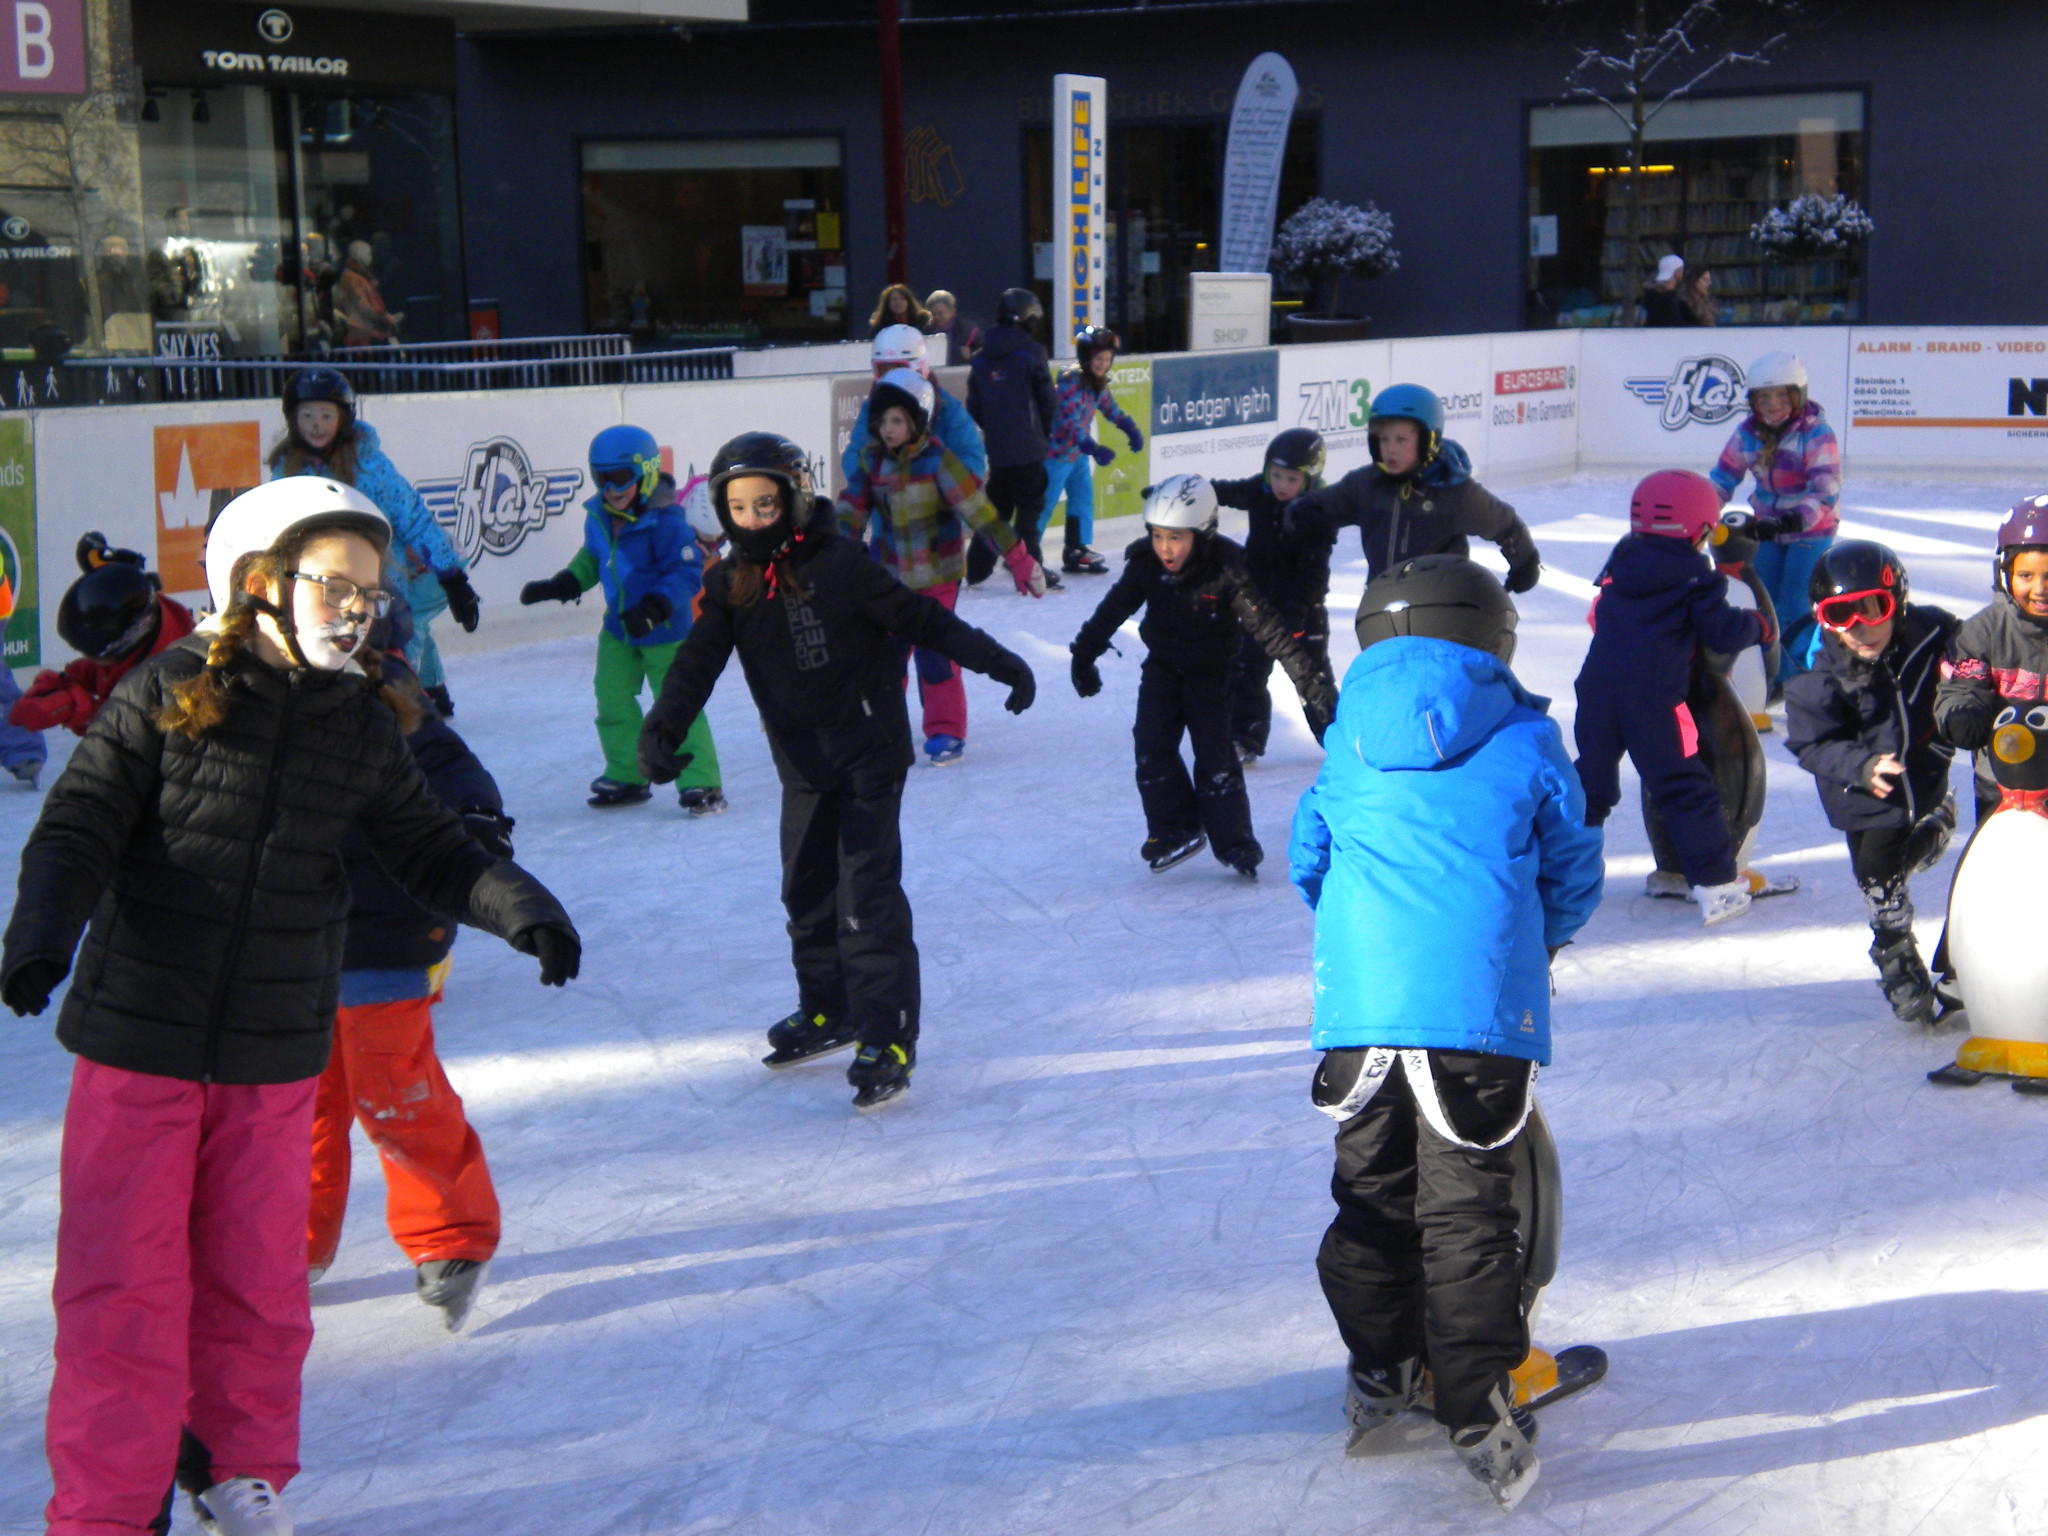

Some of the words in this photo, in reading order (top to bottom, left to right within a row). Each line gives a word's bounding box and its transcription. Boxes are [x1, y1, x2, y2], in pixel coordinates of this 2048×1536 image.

[16, 1, 54, 79] B
[203, 51, 265, 71] TOM
[267, 54, 349, 77] TAILOR
[1857, 341, 1912, 354] ALARM
[1926, 341, 1982, 354] BRAND
[1996, 341, 2047, 354] VIDEO
[1503, 370, 1567, 391] EUROSPAR
[1853, 387, 1877, 396] 6840
[1160, 393, 1182, 425] dr.
[1185, 391, 1231, 426] edgar
